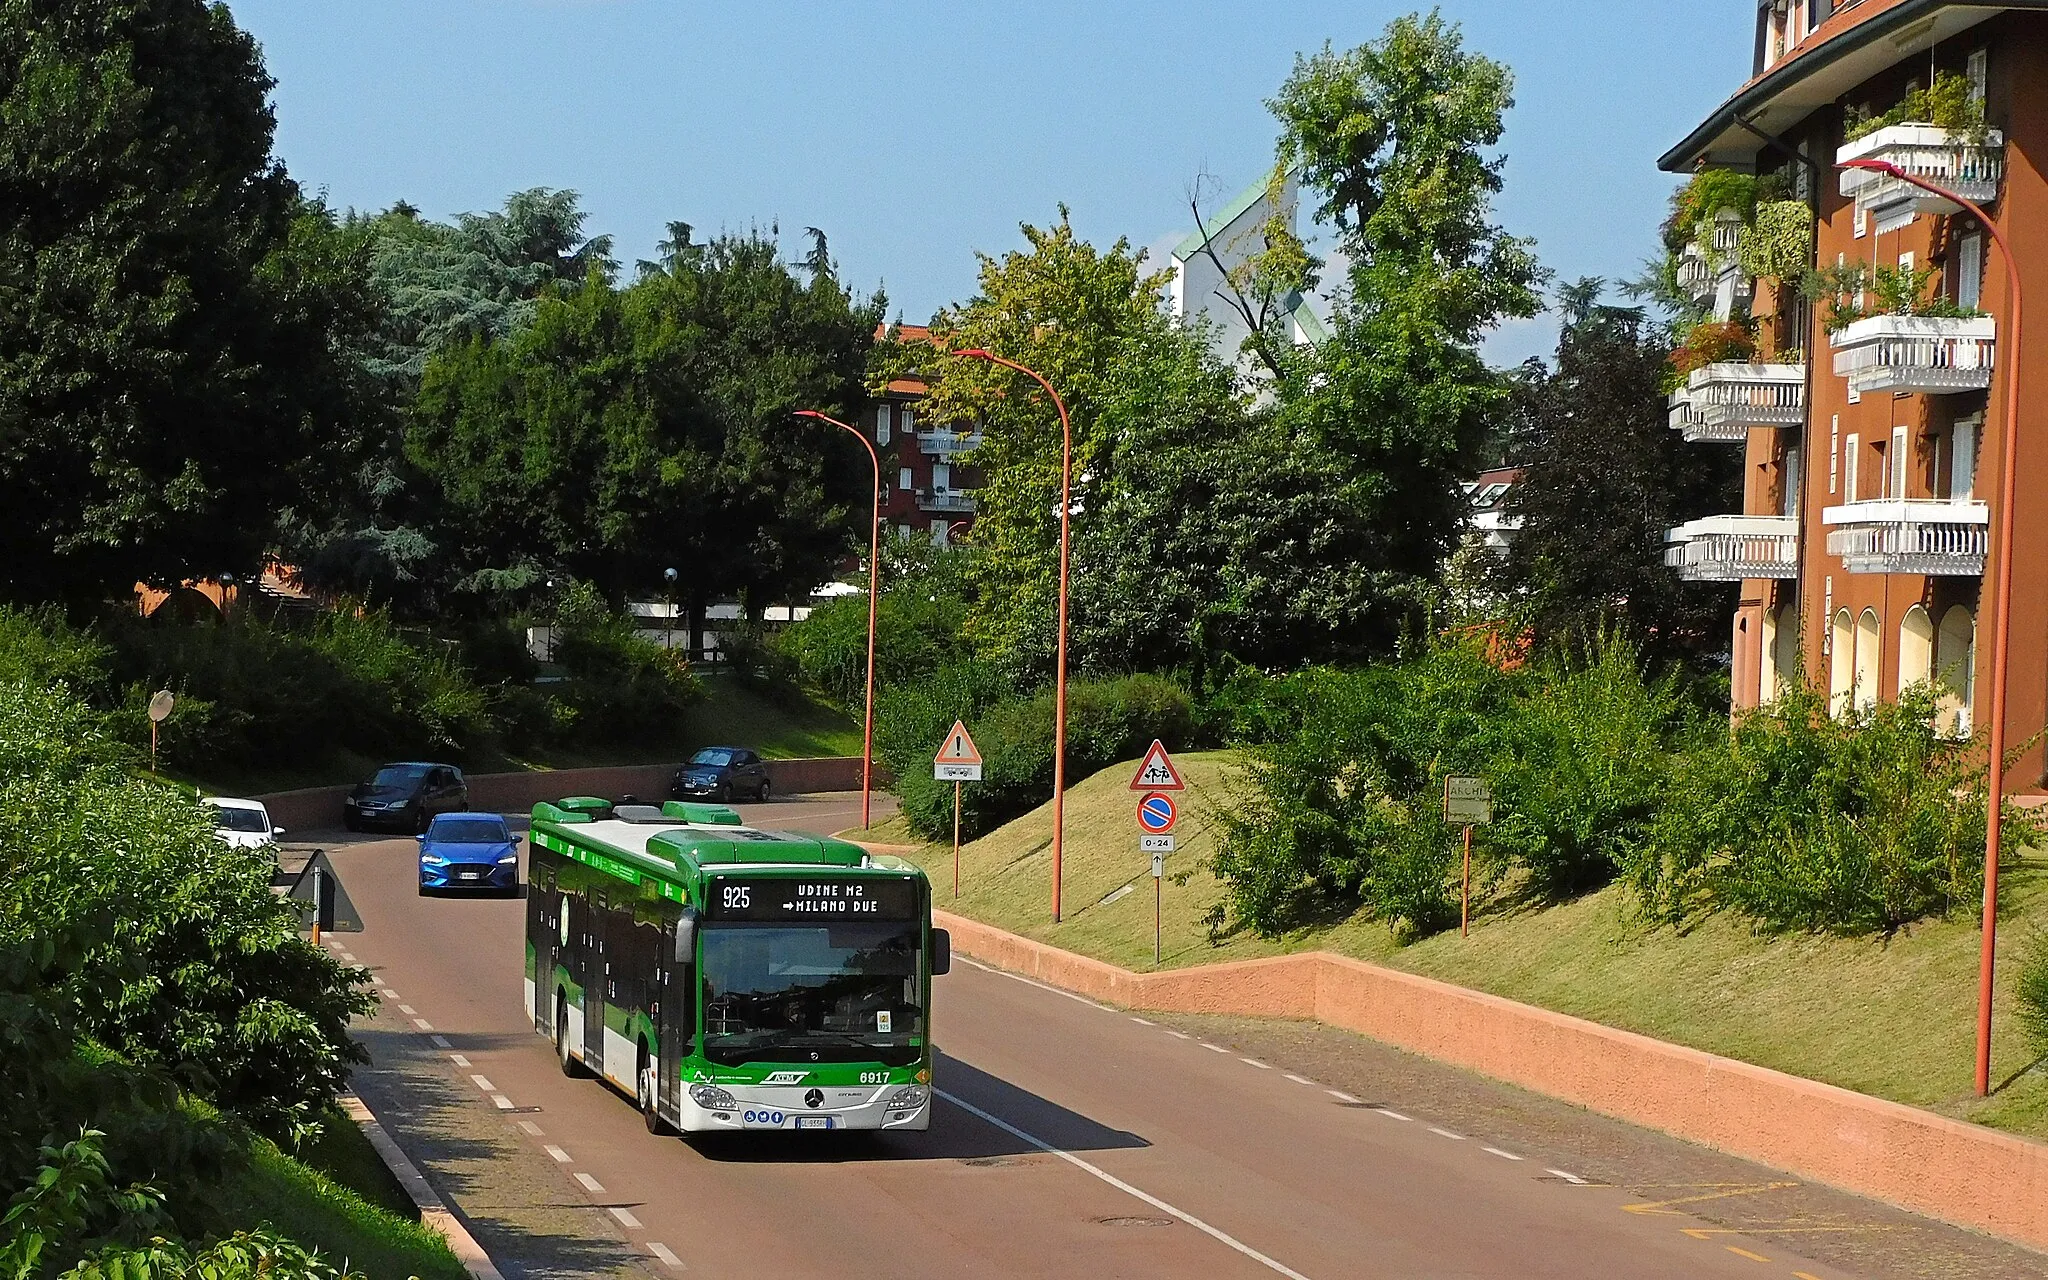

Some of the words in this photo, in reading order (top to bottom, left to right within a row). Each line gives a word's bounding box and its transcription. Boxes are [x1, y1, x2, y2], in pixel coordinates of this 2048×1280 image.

[1450, 786, 1483, 796] ARCHI
[798, 884, 839, 897] UDINE
[846, 884, 863, 897] M2
[723, 886, 750, 908] 925
[795, 900, 846, 912] MILANO
[853, 900, 878, 912] DUE
[774, 1074, 794, 1082] ATM
[859, 1071, 890, 1084] 6917
